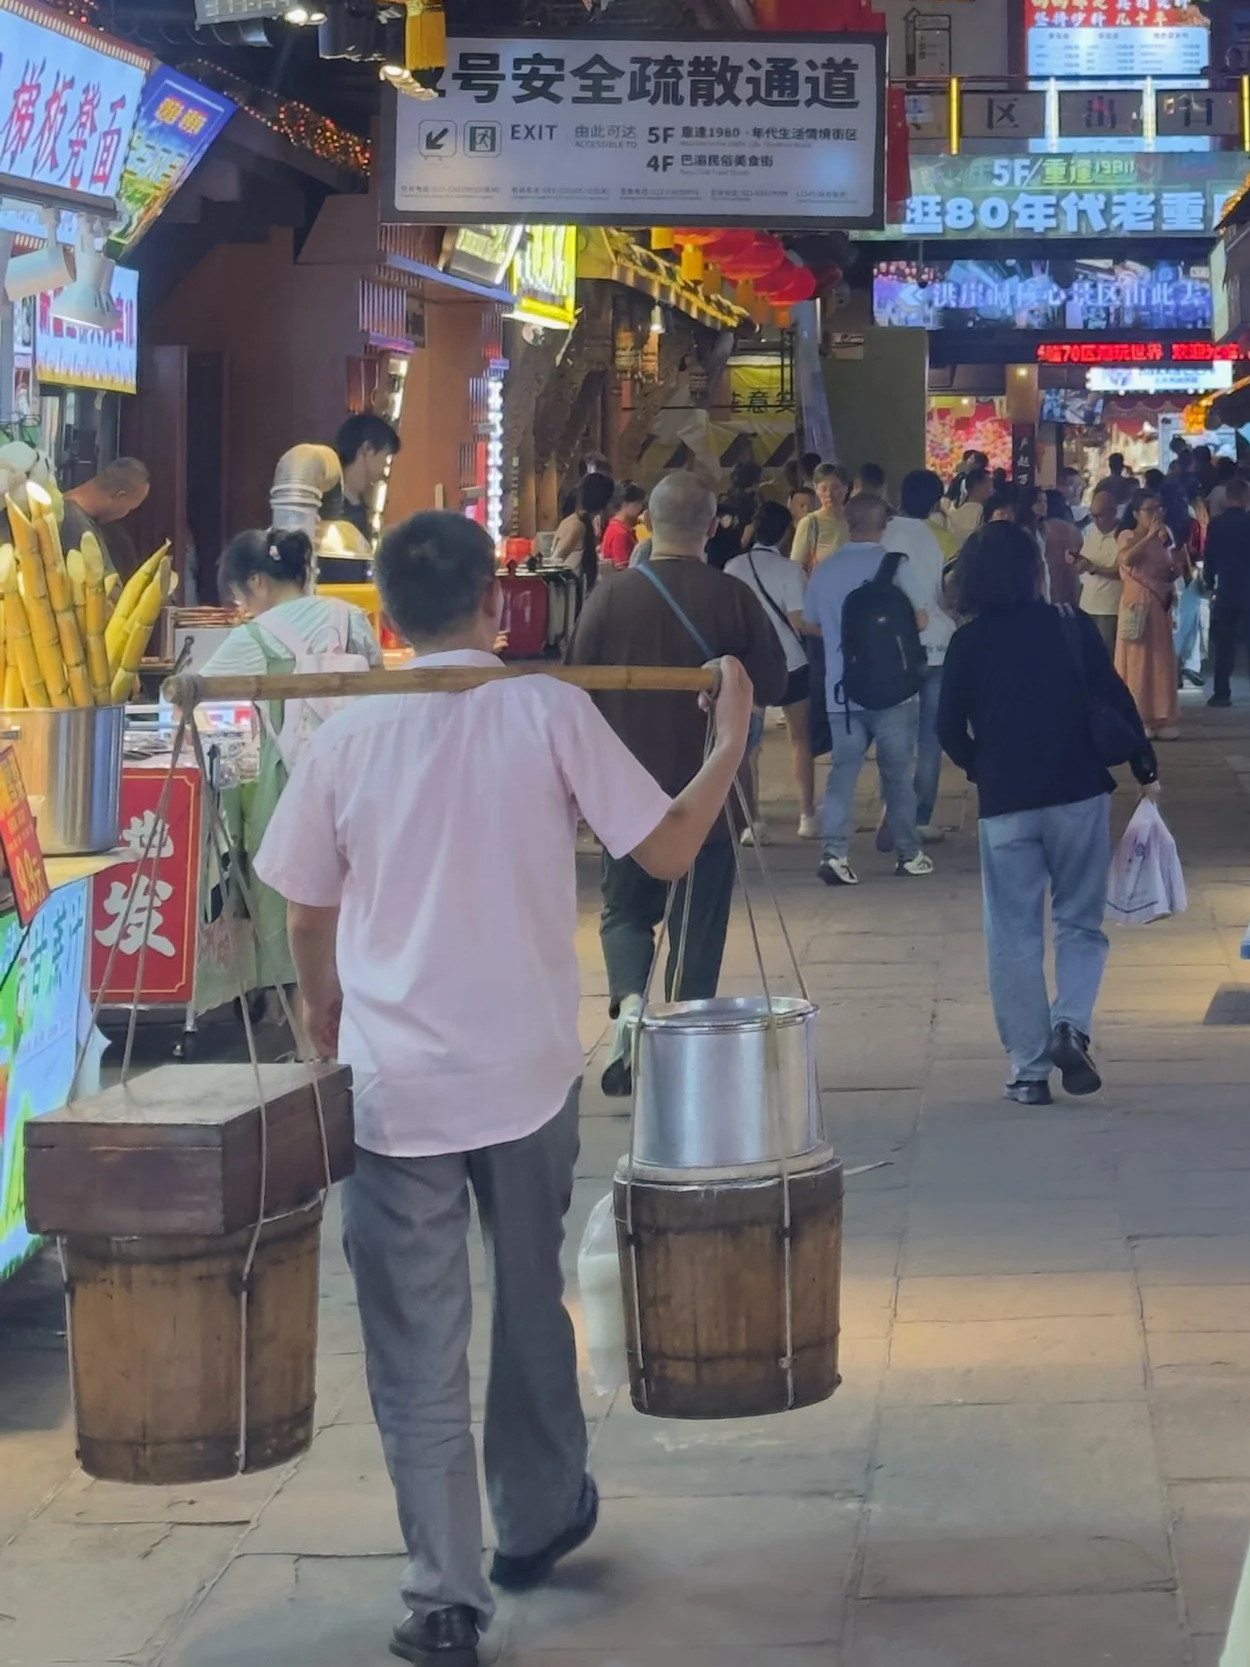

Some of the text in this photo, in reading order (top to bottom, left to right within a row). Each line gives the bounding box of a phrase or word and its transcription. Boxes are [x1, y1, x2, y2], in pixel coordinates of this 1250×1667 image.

[420, 52, 861, 110] 号安全疏散通道
[510, 124, 558, 141] EXIT
[574, 124, 637, 140] 由此可达
[647, 126, 675, 144] 5F
[646, 155, 675, 172] 4F
[902, 192, 1240, 234] 逛80年代老重
